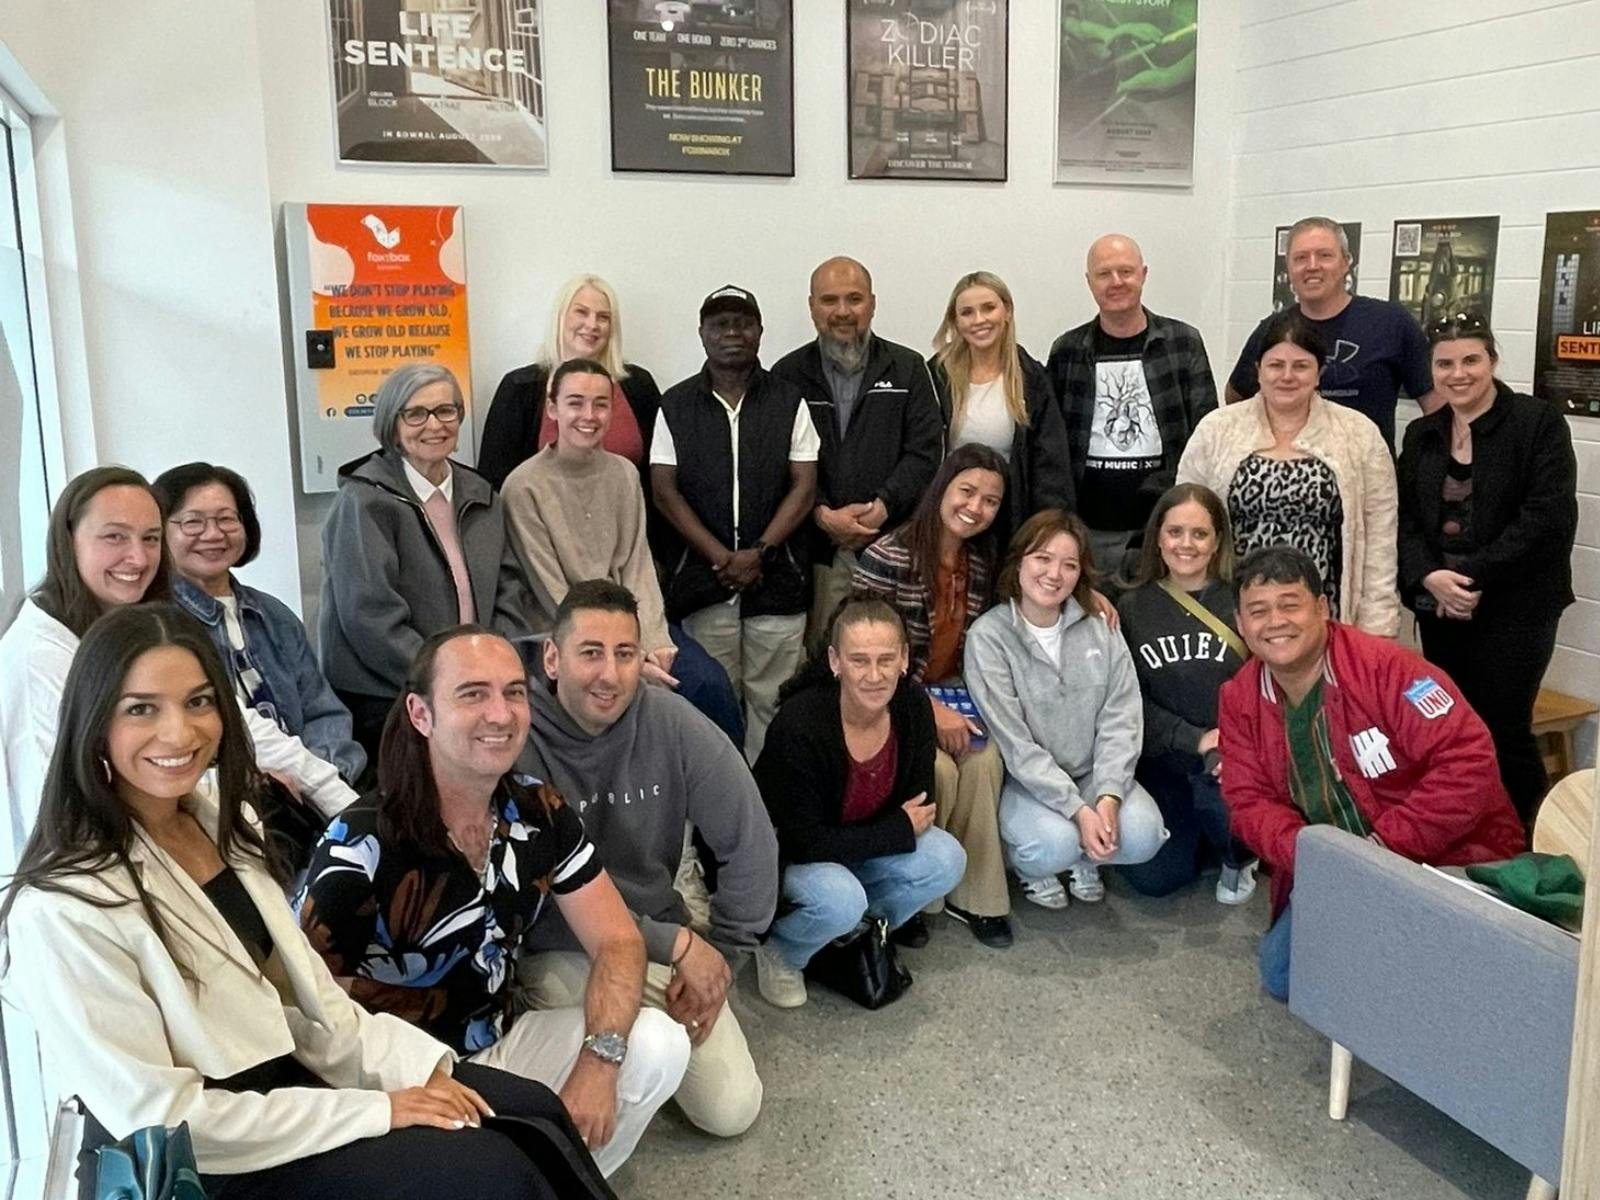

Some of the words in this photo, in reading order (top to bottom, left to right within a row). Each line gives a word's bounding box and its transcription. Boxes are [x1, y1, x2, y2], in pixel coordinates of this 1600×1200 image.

[399, 10, 472, 39] LIFE
[633, 30, 648, 42] ONE
[648, 31, 667, 43] TEAM
[676, 33, 691, 44] ONE
[719, 36, 737, 47] ZERO
[747, 38, 777, 50] CHANCES
[344, 39, 526, 73] SENTENCE
[888, 44, 975, 71] KILLER
[645, 67, 681, 98] THE
[690, 70, 763, 102] BUNKER
[382, 130, 393, 138] IN
[396, 131, 436, 140] BOWRAL
[668, 133, 690, 142] NOW
[690, 134, 731, 143] SHOWING
[731, 135, 743, 144] AT
[887, 159, 926, 169] DISCOVER
[927, 160, 943, 169] THE
[349, 284, 381, 298] DON'T
[384, 284, 410, 297] STOP
[412, 284, 456, 297] PLAYING
[329, 304, 373, 318] BECAUSE
[376, 304, 393, 317] WE
[395, 304, 426, 317] GROW
[332, 325, 349, 339] WE
[351, 325, 383, 338] GROW
[386, 324, 406, 338] OLD
[408, 324, 451, 337] BECAUSE
[345, 345, 362, 359] WE
[364, 345, 390, 358] STOP
[1560, 340, 1600, 354] SENT
[1104, 460, 1138, 470] MUSIC
